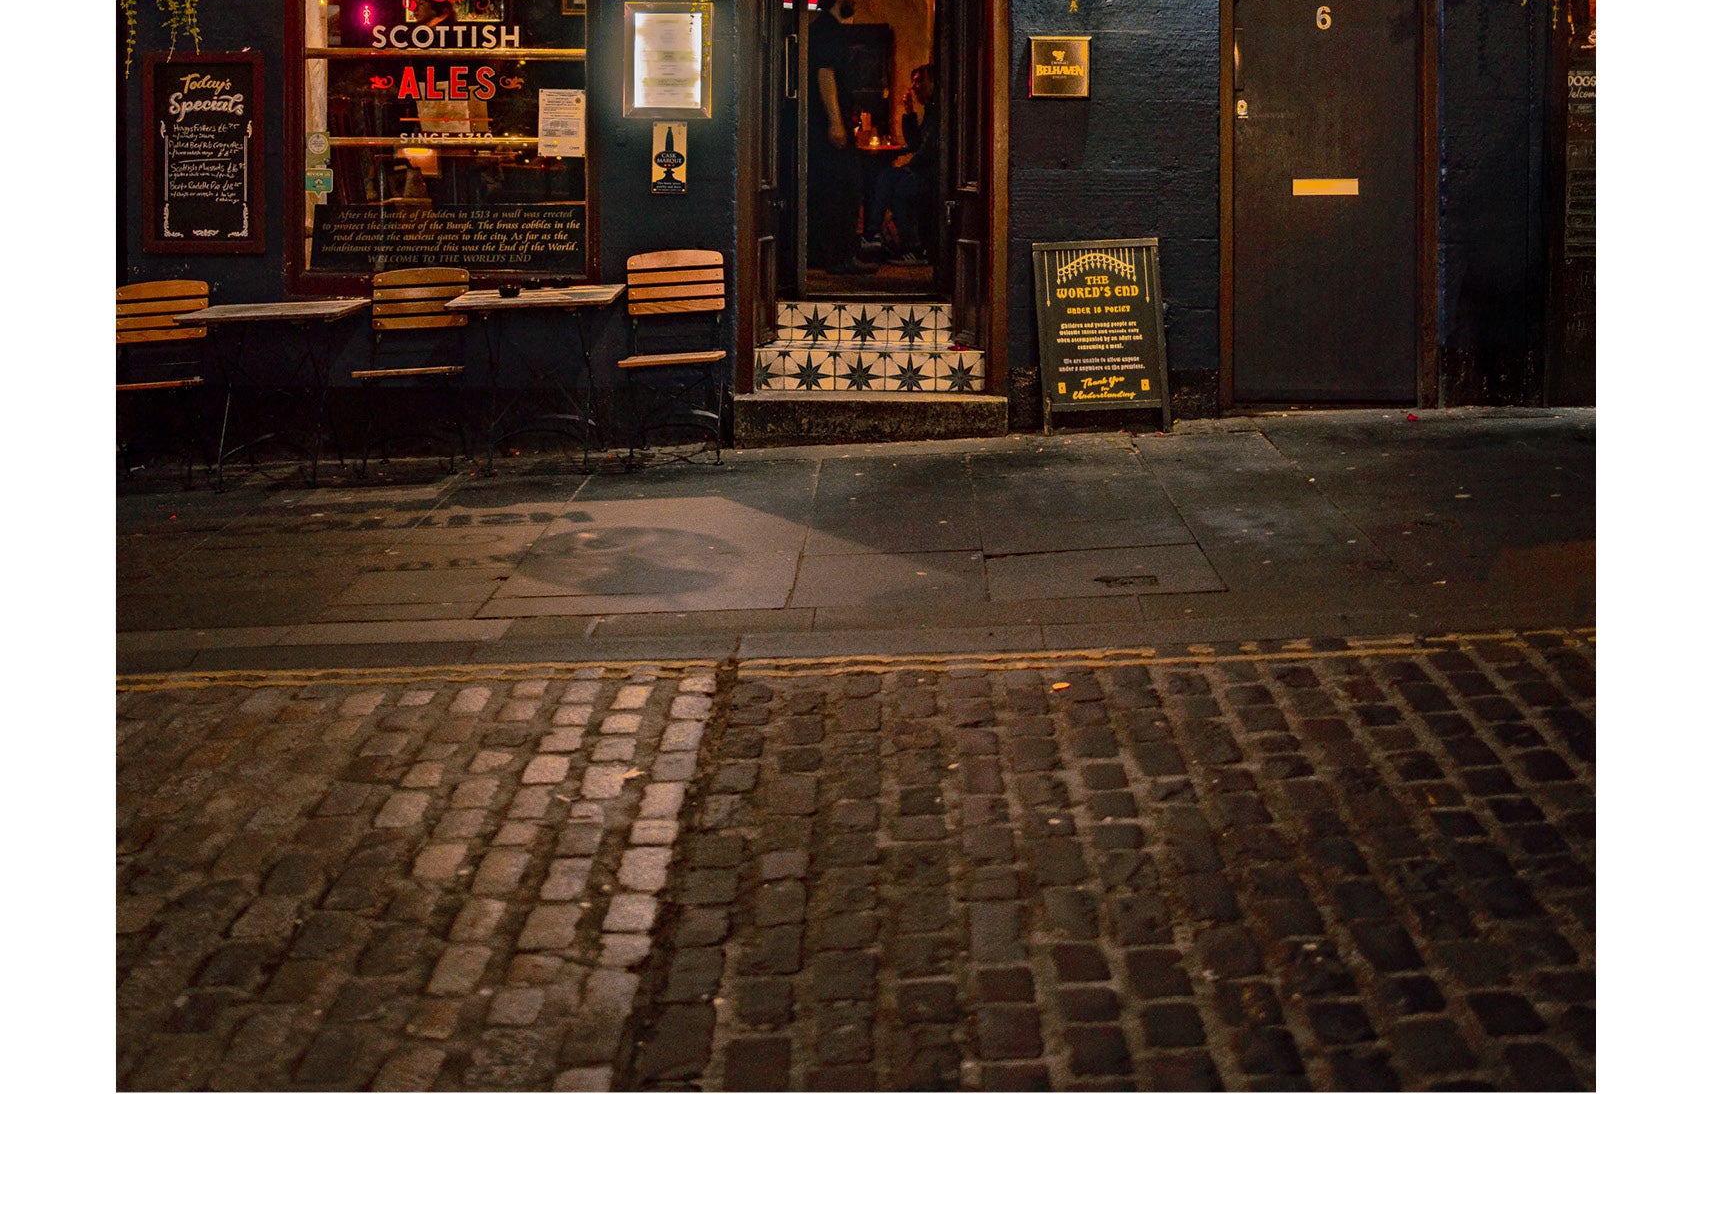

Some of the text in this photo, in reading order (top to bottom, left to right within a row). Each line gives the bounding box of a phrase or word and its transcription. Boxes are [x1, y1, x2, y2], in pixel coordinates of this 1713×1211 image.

[1316, 6, 1332, 30] 6
[372, 25, 520, 48] SCOTTISH
[1035, 64, 1085, 77] BELHAVEN
[179, 73, 232, 95] Today's
[397, 65, 497, 100] ALES
[1568, 75, 1596, 87] DOGS
[168, 92, 244, 123] Specials
[400, 133, 450, 144] SINCE
[338, 210, 362, 221] After
[364, 210, 379, 219] the
[382, 210, 407, 219] Battle
[409, 210, 419, 221] of
[421, 210, 457, 219] Flodden
[459, 211, 468, 219] in
[470, 210, 490, 219] 1513
[502, 209, 521, 219] wall
[523, 211, 540, 219] was
[543, 209, 576, 219] erected
[322, 222, 331, 230] to
[333, 221, 365, 233] protect
[367, 221, 380, 230] the
[383, 221, 415, 230] citizens
[417, 220, 428, 233] of
[429, 220, 444, 230] the
[478, 220, 495, 230] The
[496, 220, 519, 230] brass
[521, 220, 551, 230] cobbles
[554, 220, 564, 229] in
[566, 219, 581, 229] the
[333, 232, 353, 241] road
[386, 232, 401, 241] the
[402, 231, 434, 241] ancient
[438, 232, 459, 244] gates
[461, 232, 471, 240] to
[473, 231, 488, 240] the
[511, 231, 523, 240] As
[522, 231, 539, 244] far
[553, 231, 569, 240] the
[321, 242, 371, 252] inhabitants
[374, 244, 394, 252] were
[396, 242, 440, 252] concerned
[443, 242, 459, 252] this
[461, 243, 478, 251] was
[481, 242, 496, 251] the
[498, 242, 518, 251] End
[518, 242, 529, 253] of
[531, 242, 545, 251] the
[367, 255, 419, 263] WELCOME
[422, 255, 435, 263] TO
[509, 255, 532, 263] END
[1084, 275, 1109, 285] THE
[1056, 285, 1139, 299] WORLD'S END
[1066, 307, 1091, 315] UNDER
[1104, 305, 1131, 313] POLICY
[1080, 375, 1125, 389] Thank You
[1072, 390, 1137, 400] Understanding
